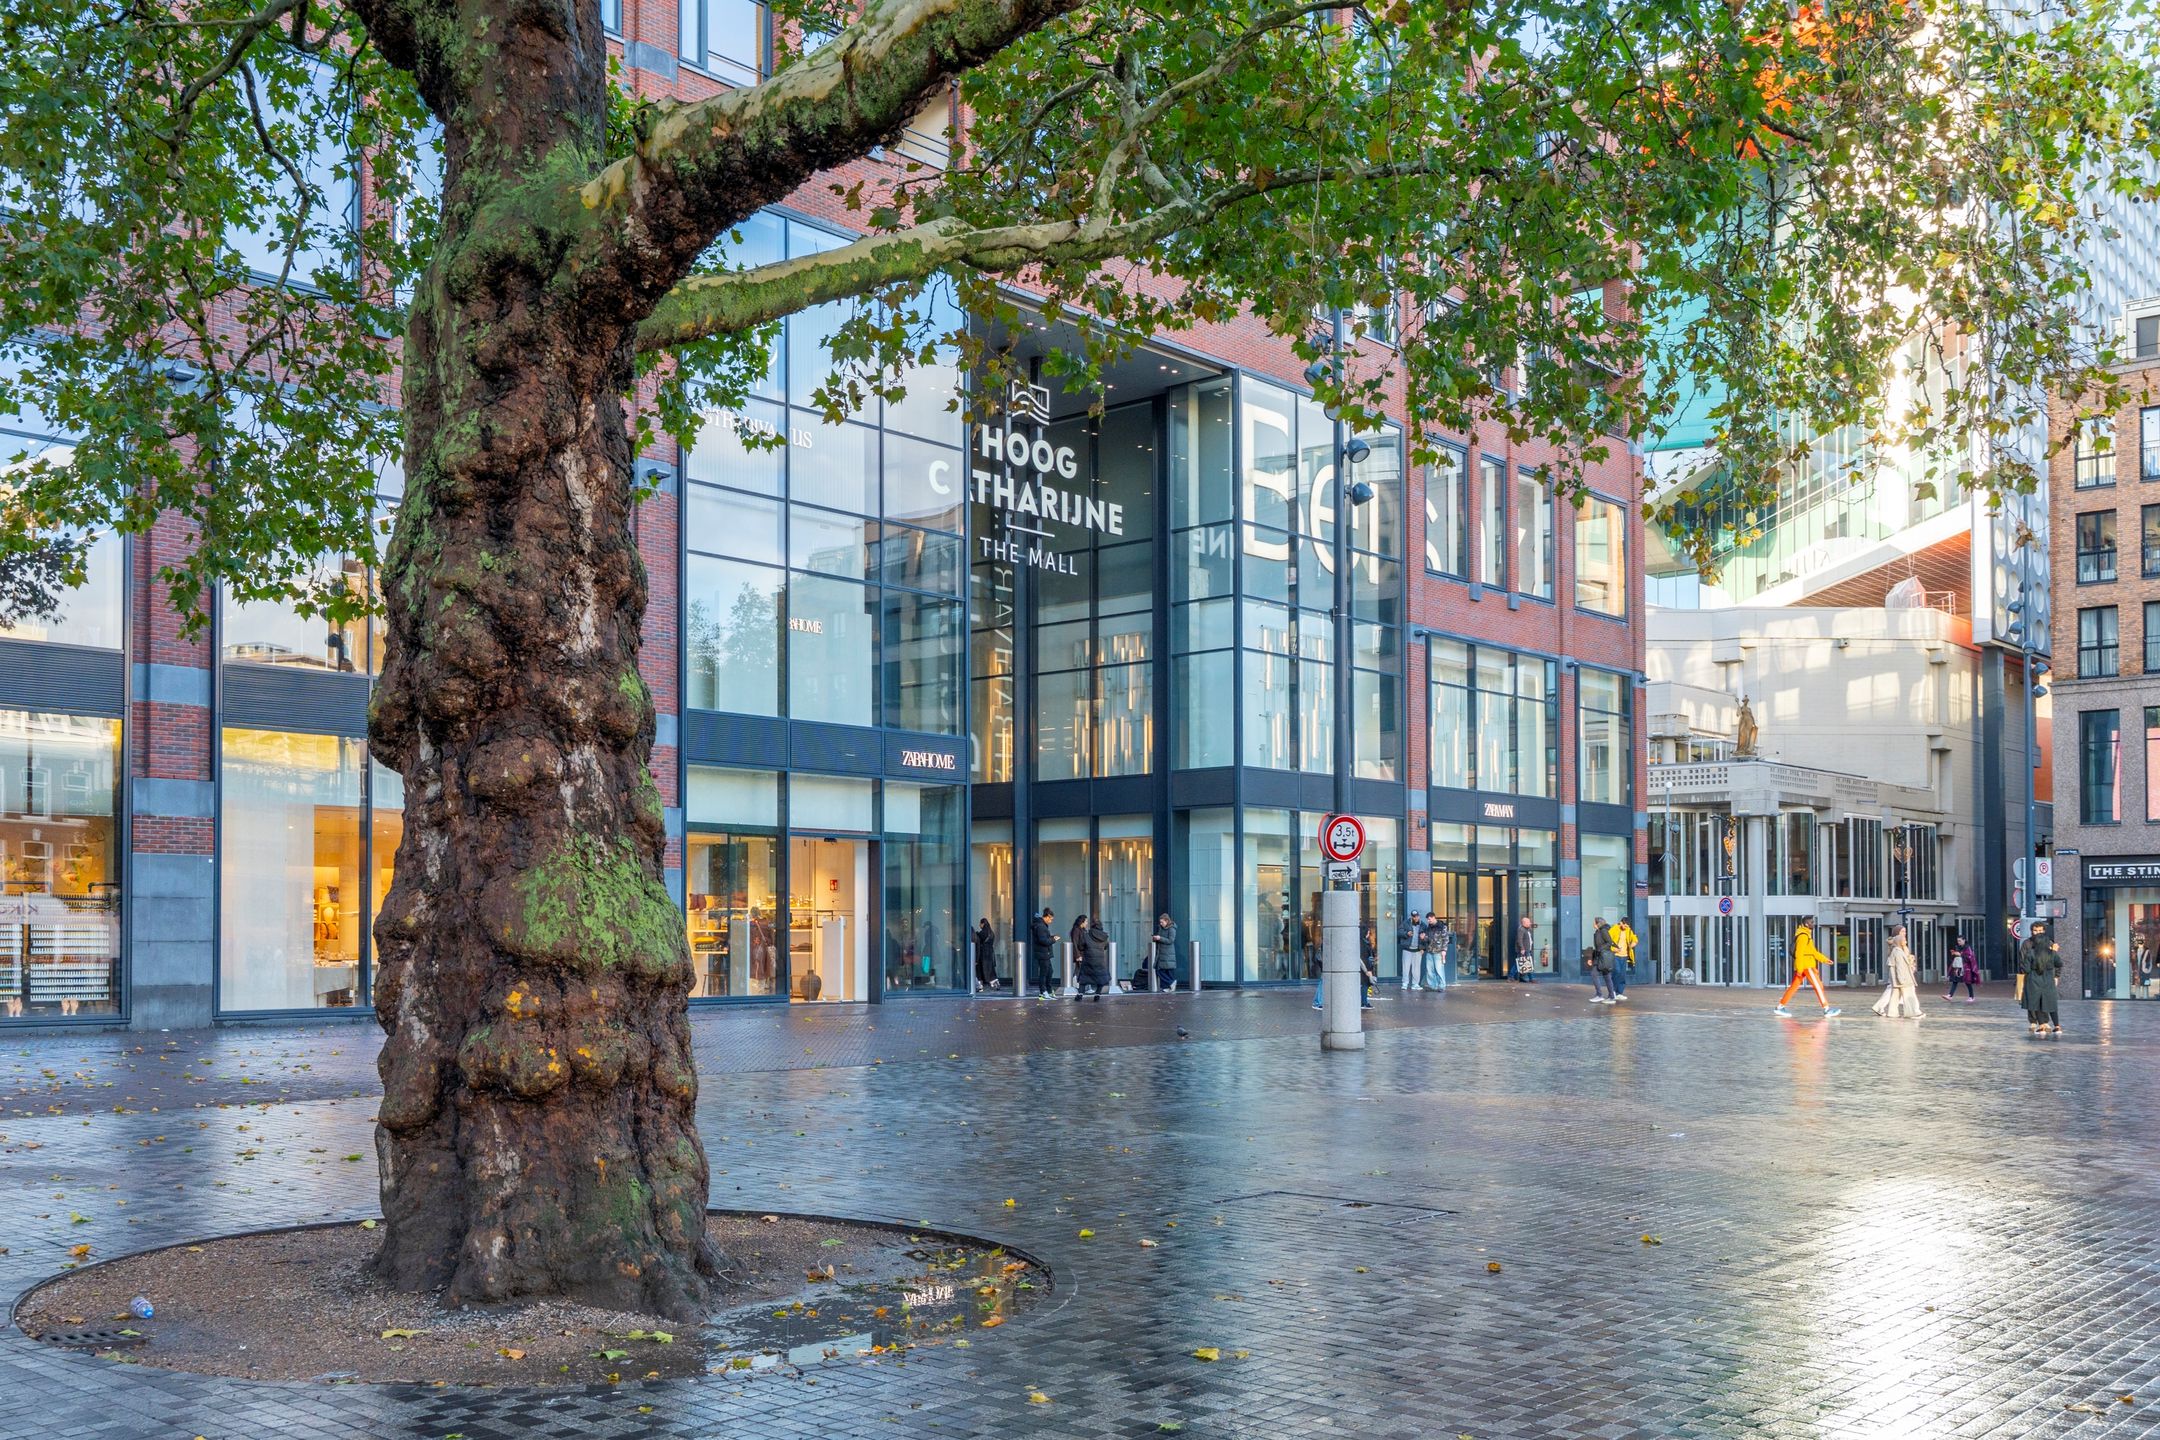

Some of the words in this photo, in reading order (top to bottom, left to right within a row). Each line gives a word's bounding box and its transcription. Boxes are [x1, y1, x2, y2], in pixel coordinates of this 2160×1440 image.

[982, 424, 1078, 480] HOOG
[980, 536, 1019, 564] THE
[1028, 547, 1078, 576] MALL
[2092, 867, 2123, 876] THE
